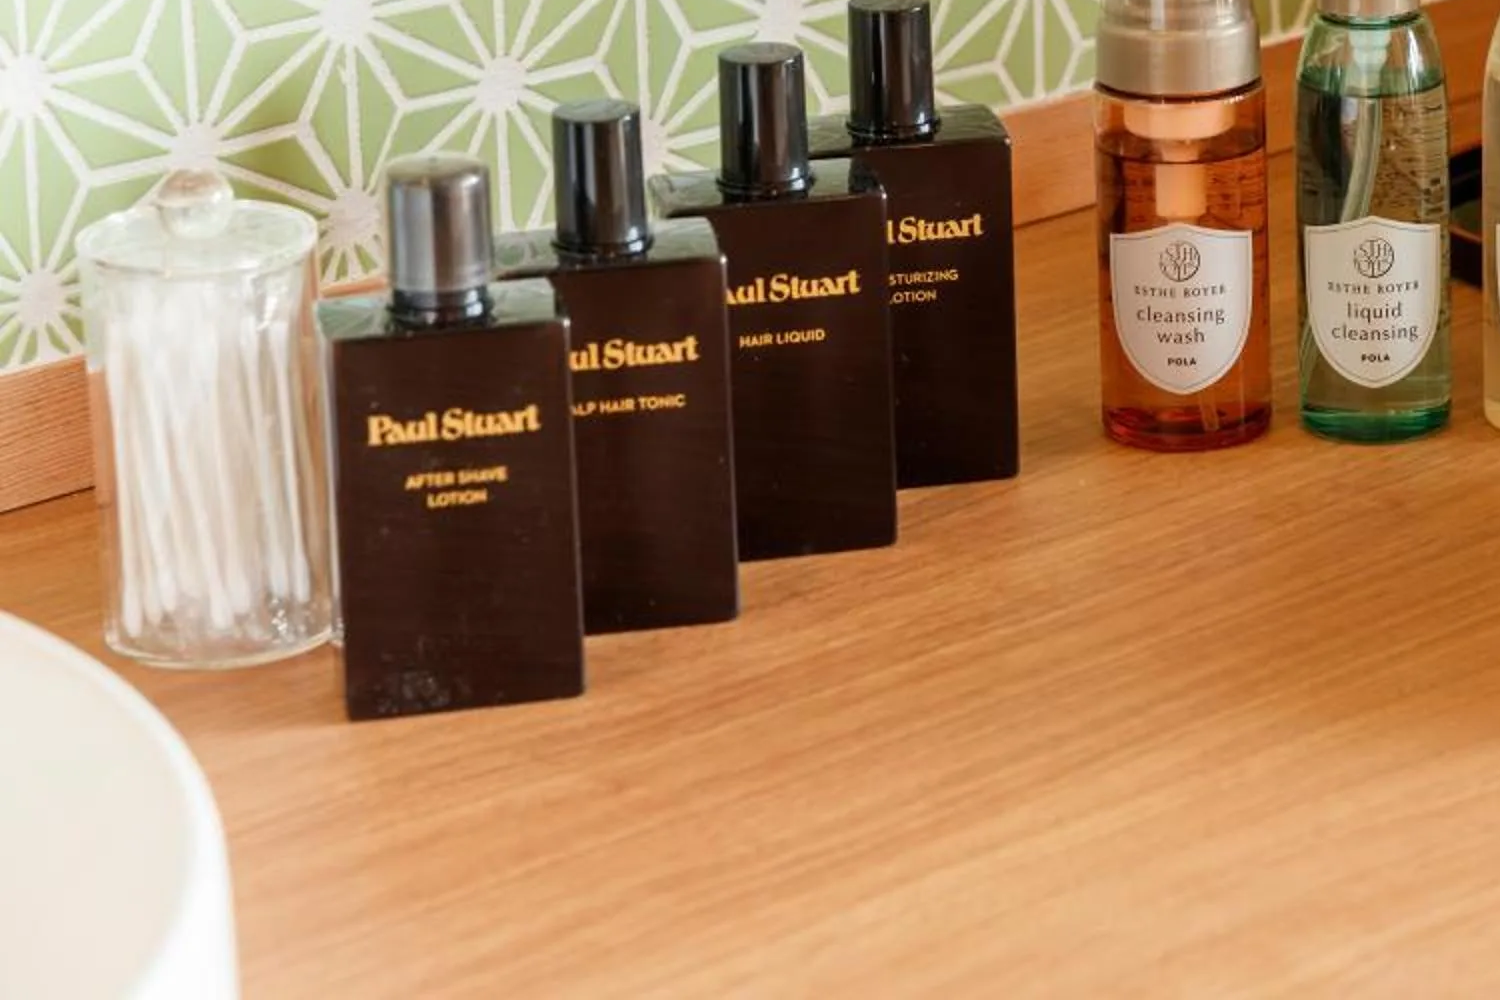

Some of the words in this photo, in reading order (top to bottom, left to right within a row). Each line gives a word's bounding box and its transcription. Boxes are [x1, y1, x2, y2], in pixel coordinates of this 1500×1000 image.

[897, 213, 984, 244] Stuart
[725, 276, 767, 305] aul
[769, 269, 861, 302] Stuart
[889, 269, 959, 287] STURIZING
[1327, 281, 1371, 294] ESTHE
[1377, 280, 1419, 294] ROYER
[890, 290, 938, 304] OTION
[1133, 285, 1177, 298] ESTHE
[1183, 284, 1227, 298] ROYER
[1136, 305, 1225, 325] cleansing
[1347, 301, 1403, 324] liquid
[739, 333, 773, 348] HAIR
[776, 328, 826, 345] LIQUID
[1156, 327, 1205, 344] wash
[1331, 323, 1419, 342] cleansing
[569, 343, 600, 372] ul
[603, 335, 699, 370] Stuart
[1167, 357, 1197, 367] POLA
[1361, 353, 1391, 363] POLA
[600, 397, 635, 413] HAIR
[638, 393, 687, 409] TONIC
[367, 411, 438, 446] Paul
[441, 404, 542, 440] Stuart
[405, 471, 455, 490] AFTER
[457, 465, 508, 486] SHAVE
[426, 488, 488, 508] LOTION
